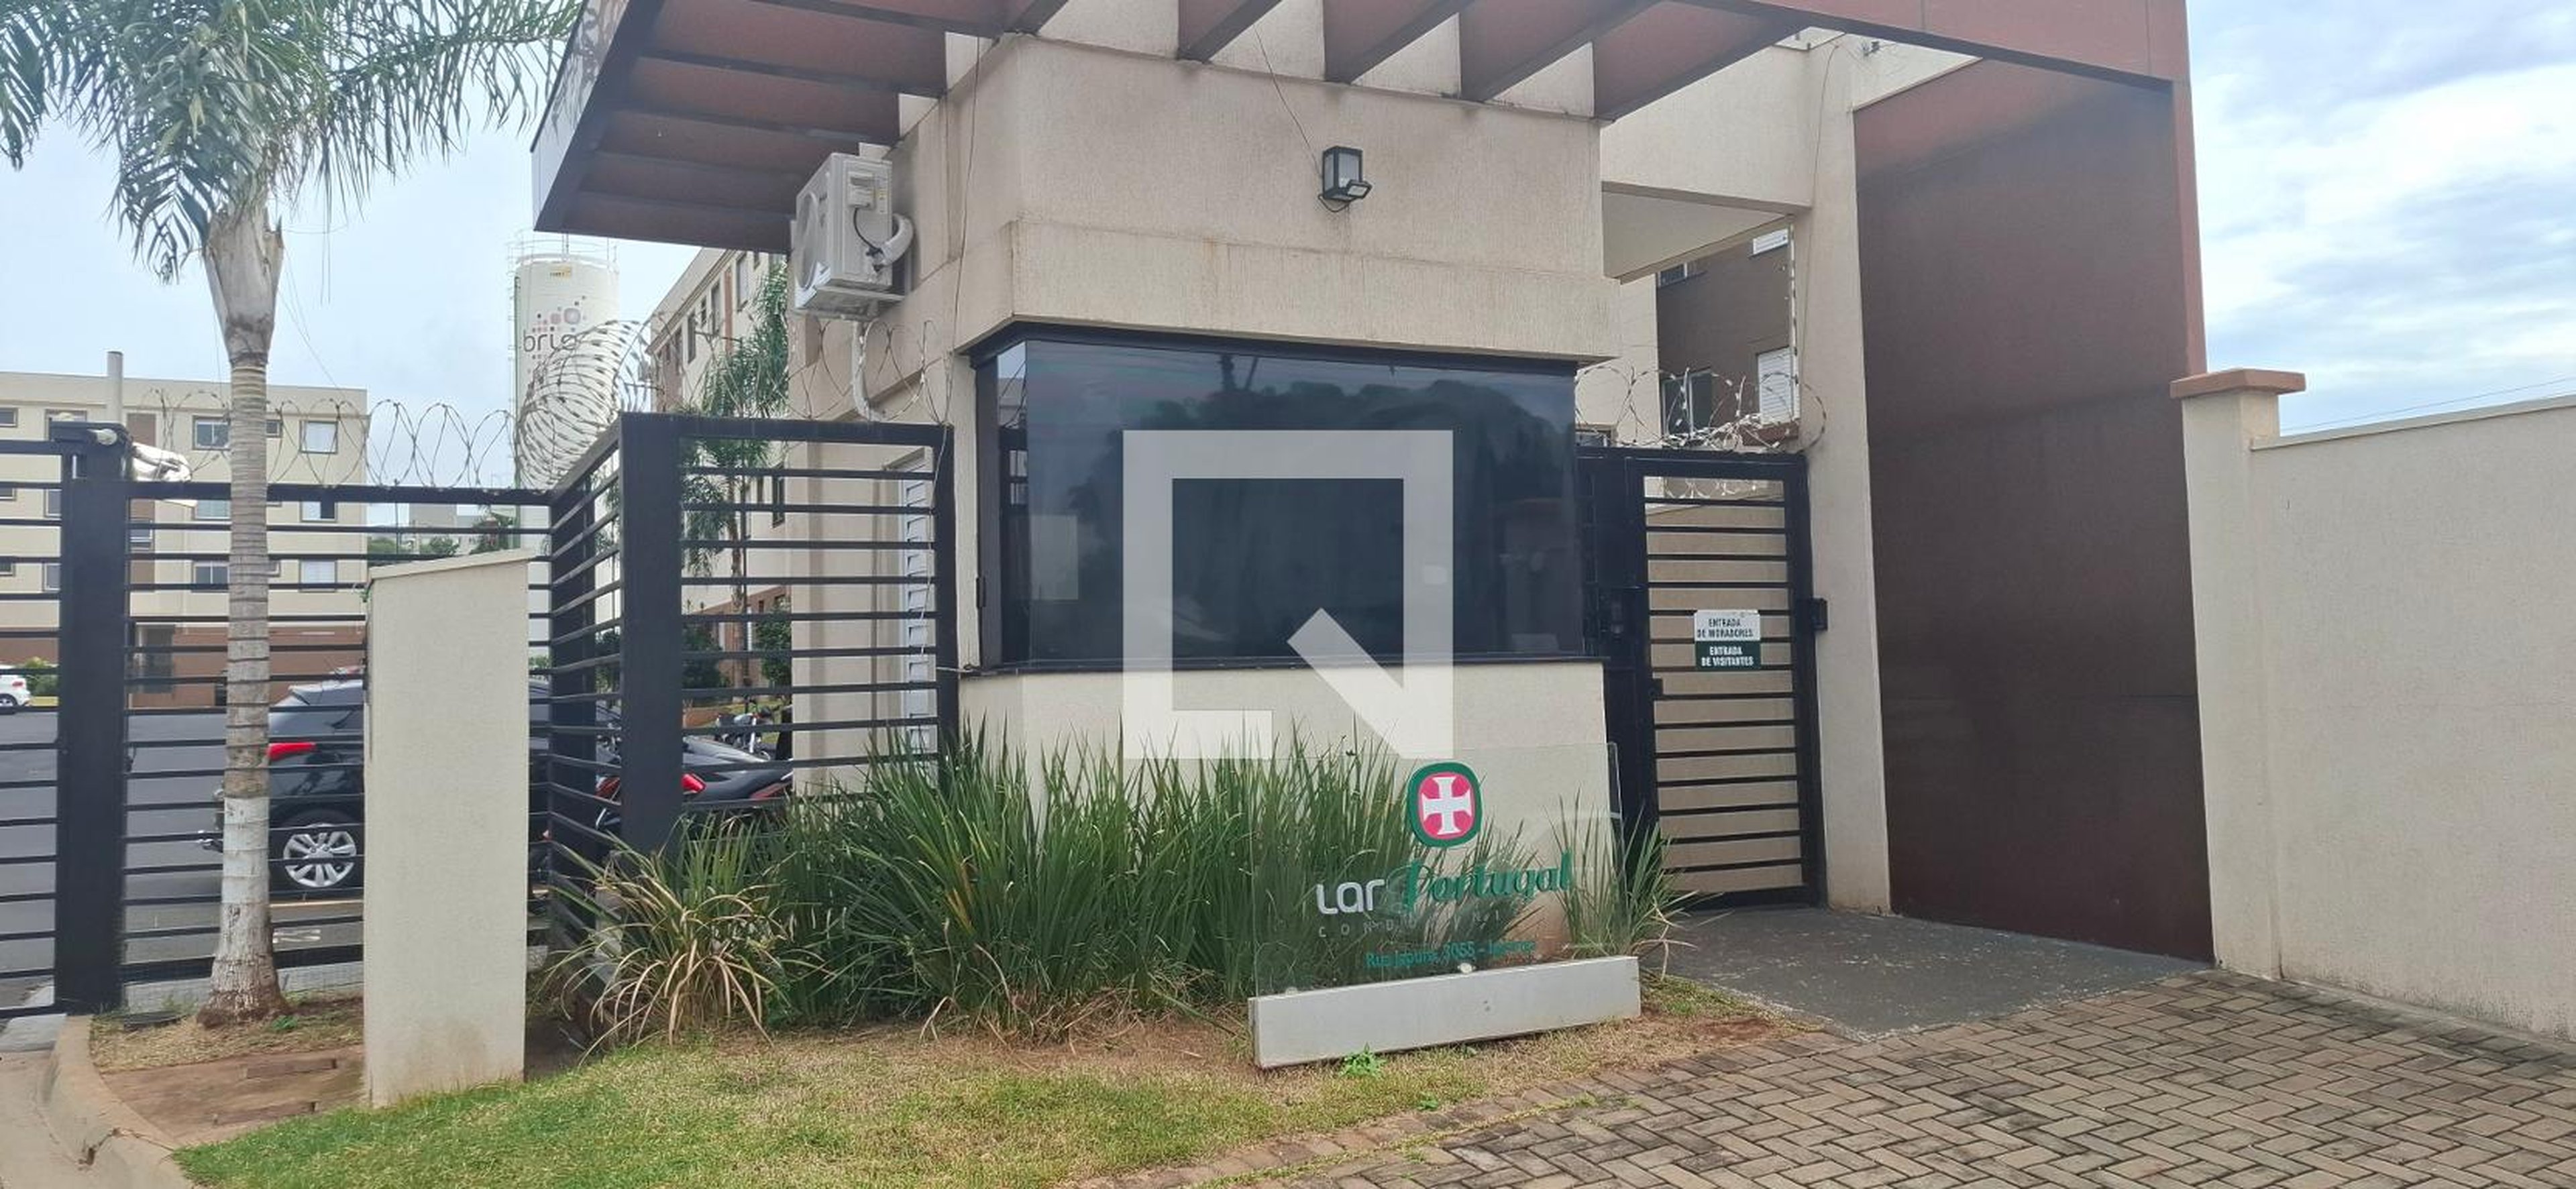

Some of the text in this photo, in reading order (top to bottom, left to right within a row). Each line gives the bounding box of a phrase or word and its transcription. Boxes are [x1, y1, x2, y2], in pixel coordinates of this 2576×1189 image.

[1708, 618, 1741, 628] ENTRADA
[1709, 646, 1743, 656] ENTRADA
[1701, 656, 1754, 667] DE VISITANTES
